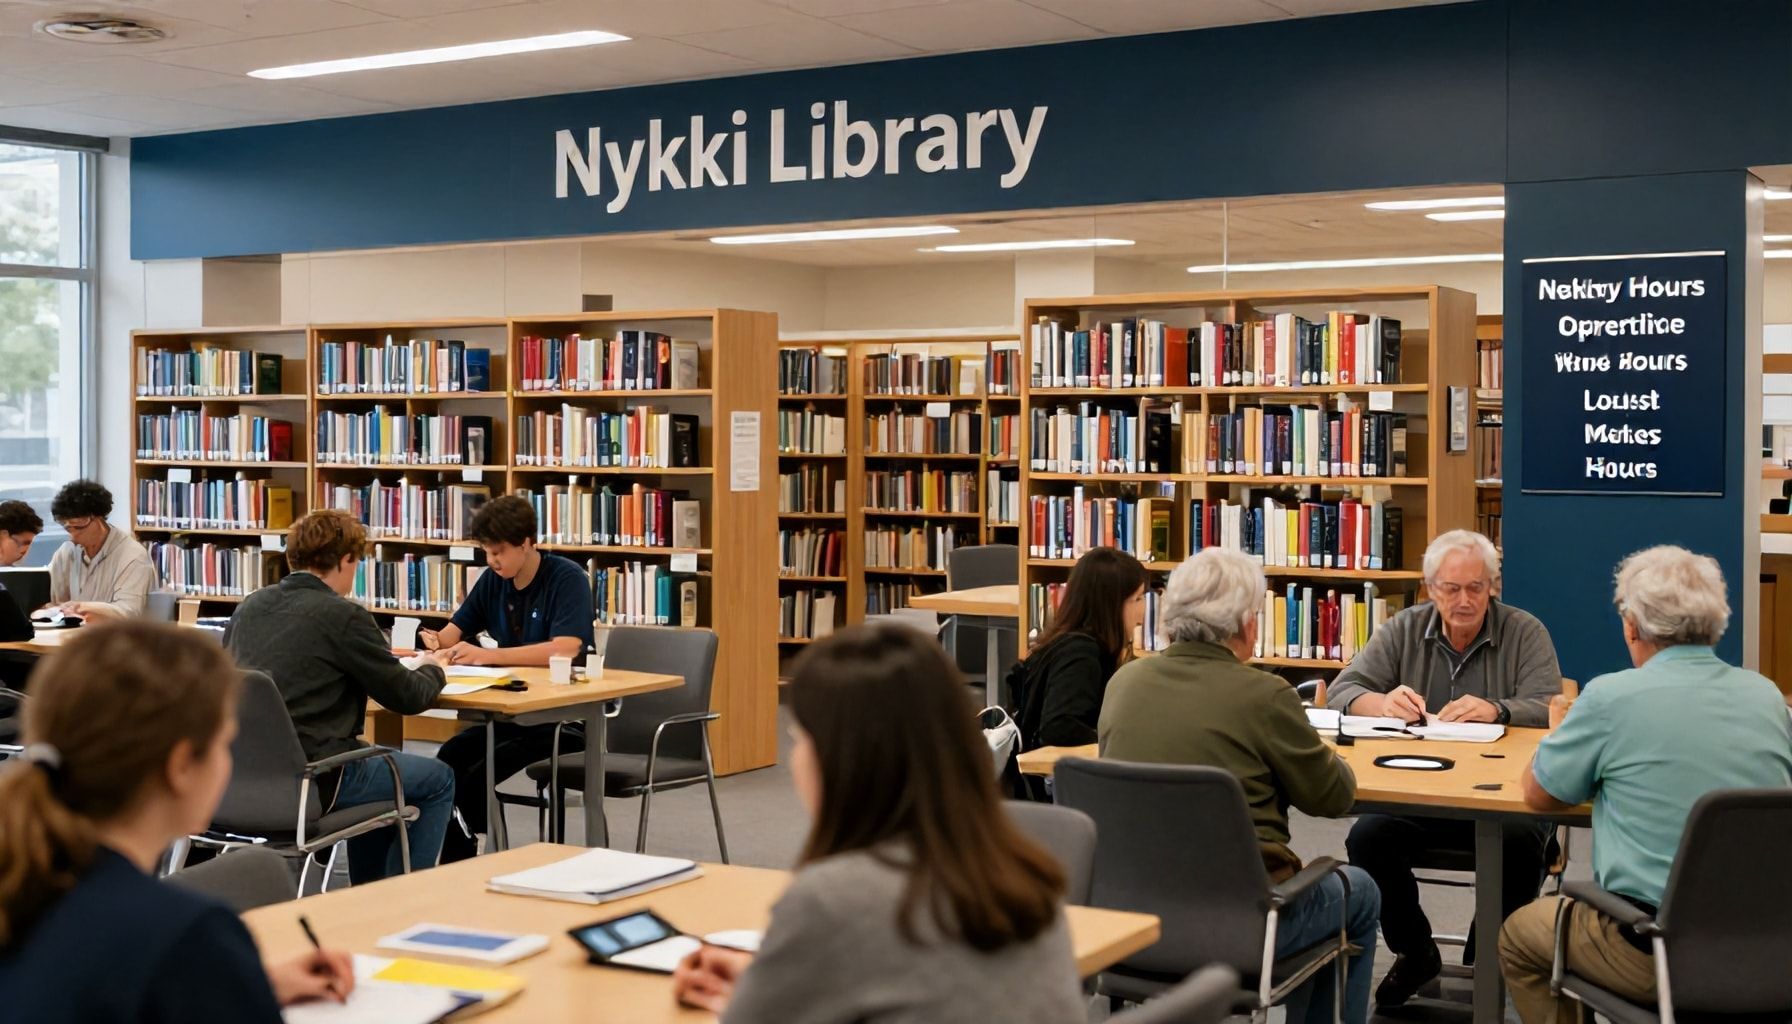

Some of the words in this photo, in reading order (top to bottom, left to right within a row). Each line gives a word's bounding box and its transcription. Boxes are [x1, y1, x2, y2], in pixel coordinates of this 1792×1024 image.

[555, 109, 747, 214] Nykki
[769, 100, 1049, 189] Library
[1627, 275, 1706, 298] Hours
[1585, 456, 1658, 479] Hours
